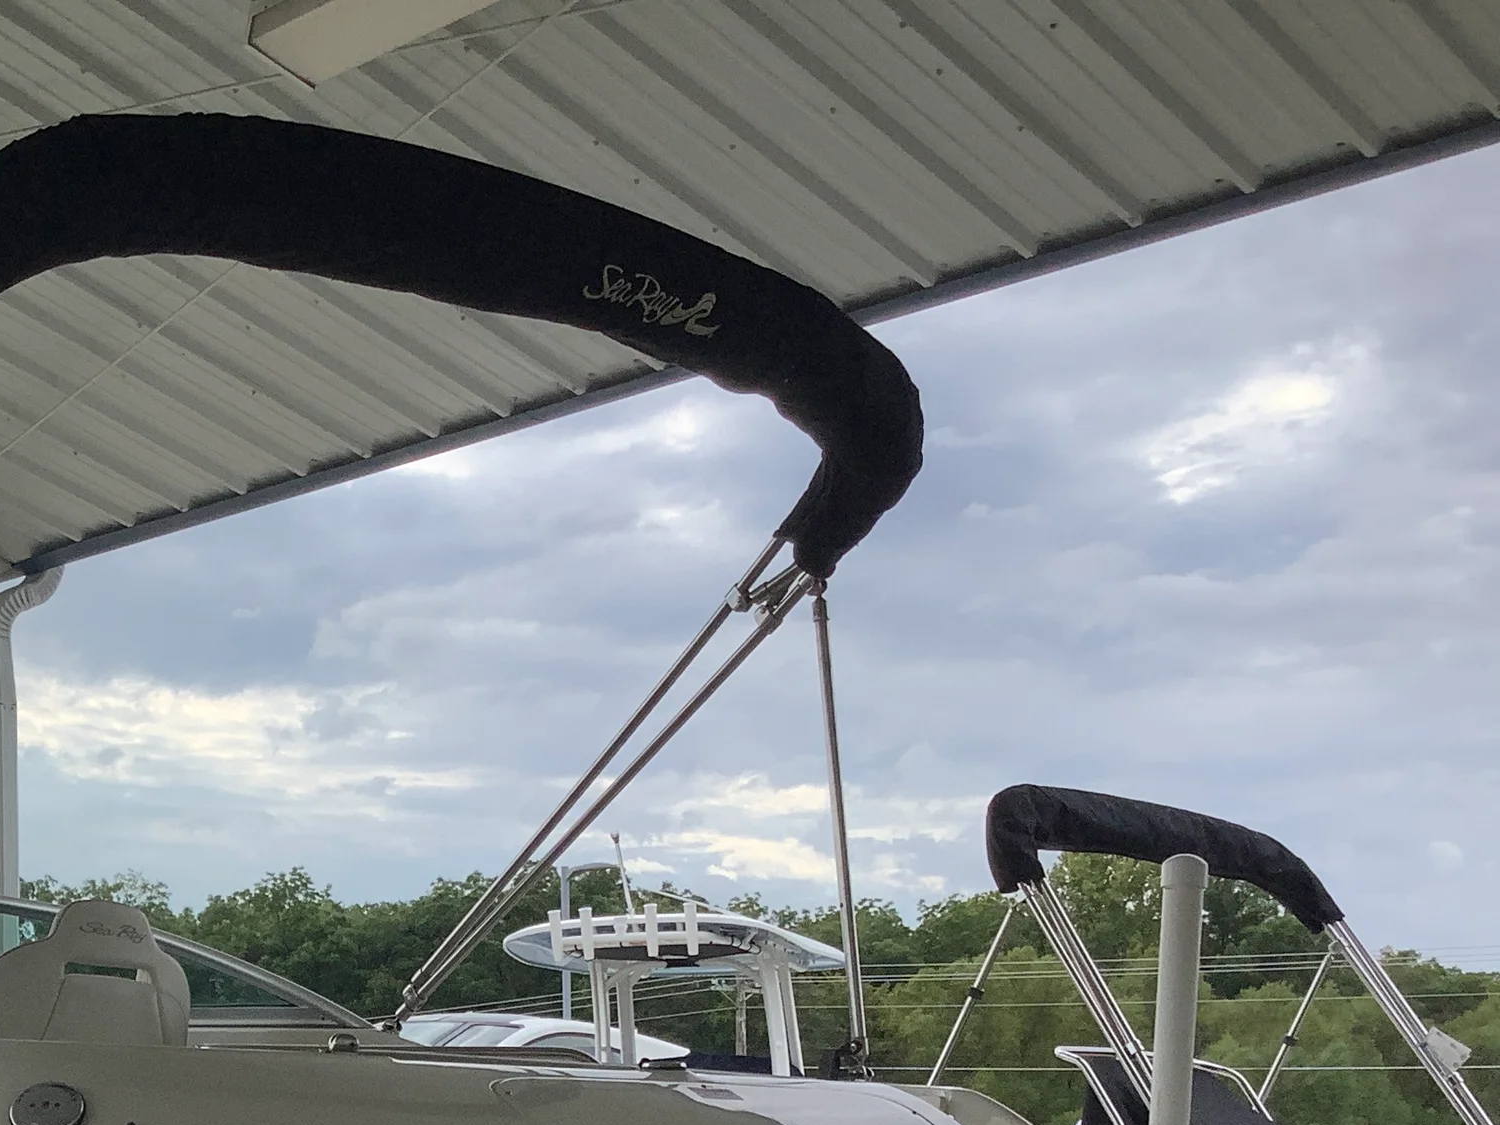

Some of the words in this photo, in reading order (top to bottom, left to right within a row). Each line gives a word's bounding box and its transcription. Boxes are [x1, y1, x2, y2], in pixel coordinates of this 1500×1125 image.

[583, 264, 634, 306] Sea
[627, 272, 682, 325] Ray
[79, 921, 115, 937] Sea
[116, 924, 147, 944] Ray
